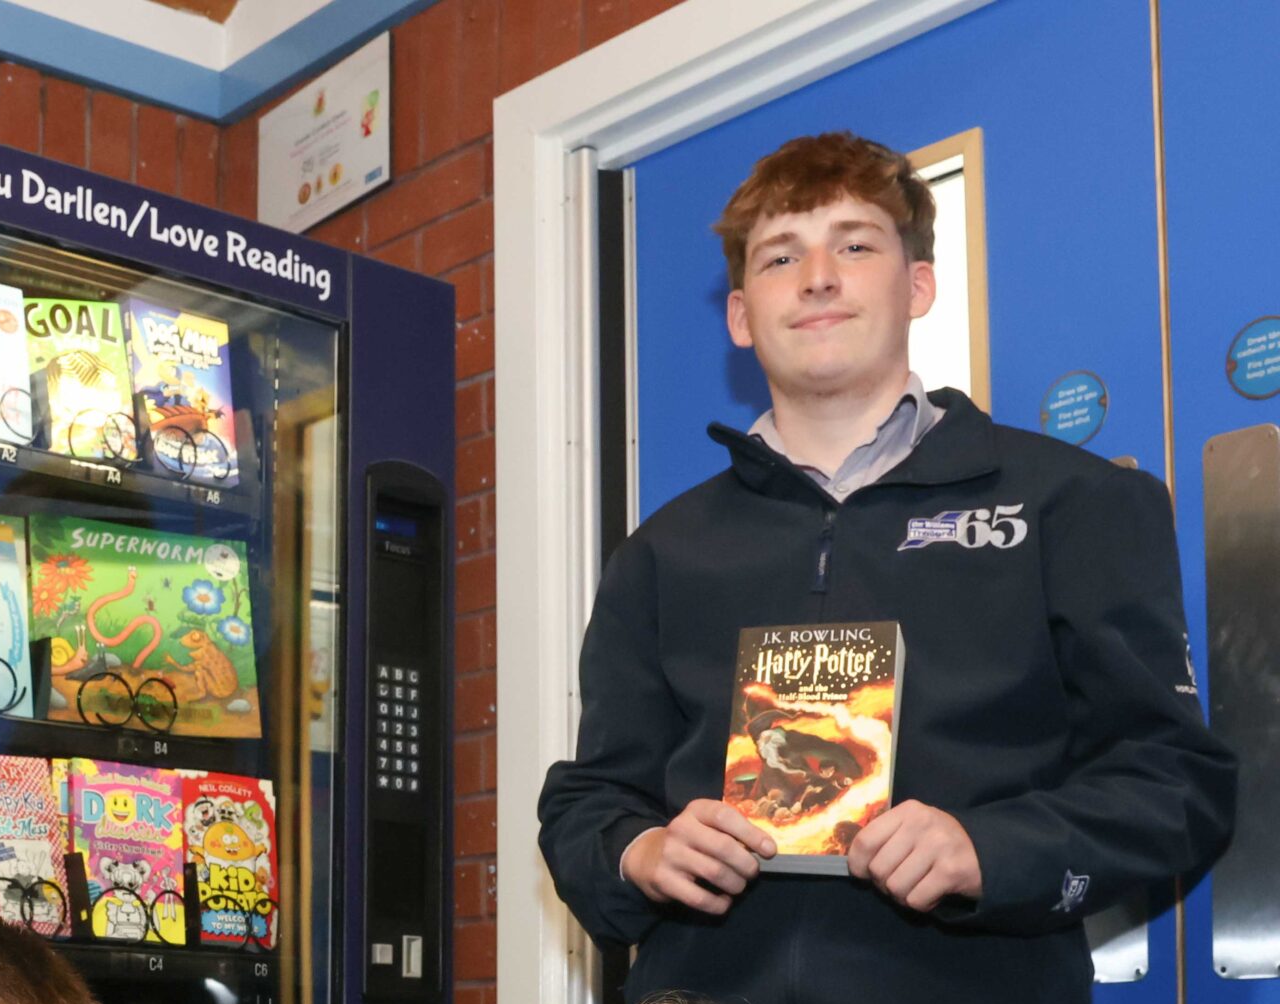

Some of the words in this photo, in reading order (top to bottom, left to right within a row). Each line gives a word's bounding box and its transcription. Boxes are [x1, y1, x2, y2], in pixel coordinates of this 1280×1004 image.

[21, 168, 218, 258] Darllen/Love
[226, 231, 332, 302] Reading
[24, 303, 117, 343] GOAL
[2, 448, 17, 462] A2
[107, 471, 121, 485] A4
[207, 490, 220, 504] A6
[956, 503, 1028, 548] 65
[71, 527, 205, 565] SUPERWORM
[762, 632, 785, 645] J.K.
[790, 628, 872, 643] ROWLING
[752, 649, 812, 684] Harry
[813, 644, 875, 684] Potter
[380, 667, 388, 679] A
[395, 668, 403, 680] B
[410, 671, 417, 683] C
[395, 687, 402, 698] E
[411, 690, 417, 700] F
[798, 684, 813, 692] and
[815, 684, 828, 692] the
[779, 693, 821, 701] Half-Blood
[380, 703, 388, 714] G
[395, 705, 403, 716] H
[411, 708, 417, 719] J
[382, 721, 387, 732] 1
[396, 724, 402, 735] 2
[411, 726, 417, 737] 3
[154, 741, 168, 754] B4
[380, 739, 387, 750] 4
[396, 741, 402, 753] 5
[411, 744, 417, 754] 6
[380, 757, 387, 768] 7
[396, 759, 403, 770] 8
[411, 762, 417, 773] 9
[199, 784, 217, 792] NEIL
[23, 793, 44, 810] Kid
[15, 819, 48, 836] Mess
[149, 957, 163, 971] C4
[254, 963, 268, 977] C6
